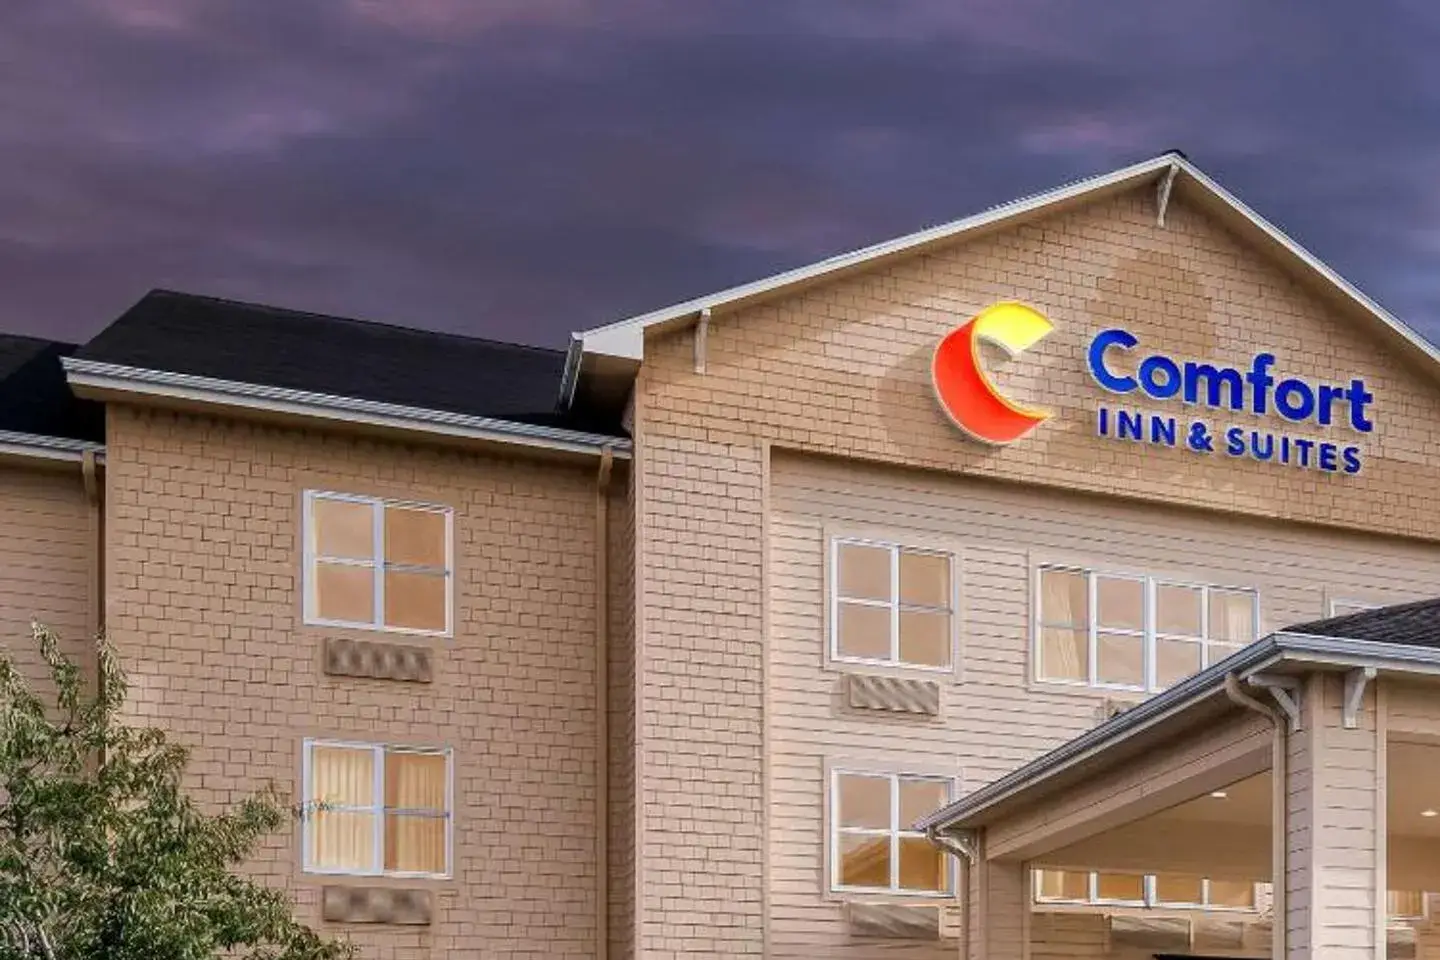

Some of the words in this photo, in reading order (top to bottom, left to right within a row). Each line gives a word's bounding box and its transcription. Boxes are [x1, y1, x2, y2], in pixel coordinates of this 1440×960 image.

[1087, 329, 1374, 432] Comfort
[1099, 408, 1176, 446] INN
[1187, 421, 1215, 452] &
[1226, 427, 1362, 474] SUITES
